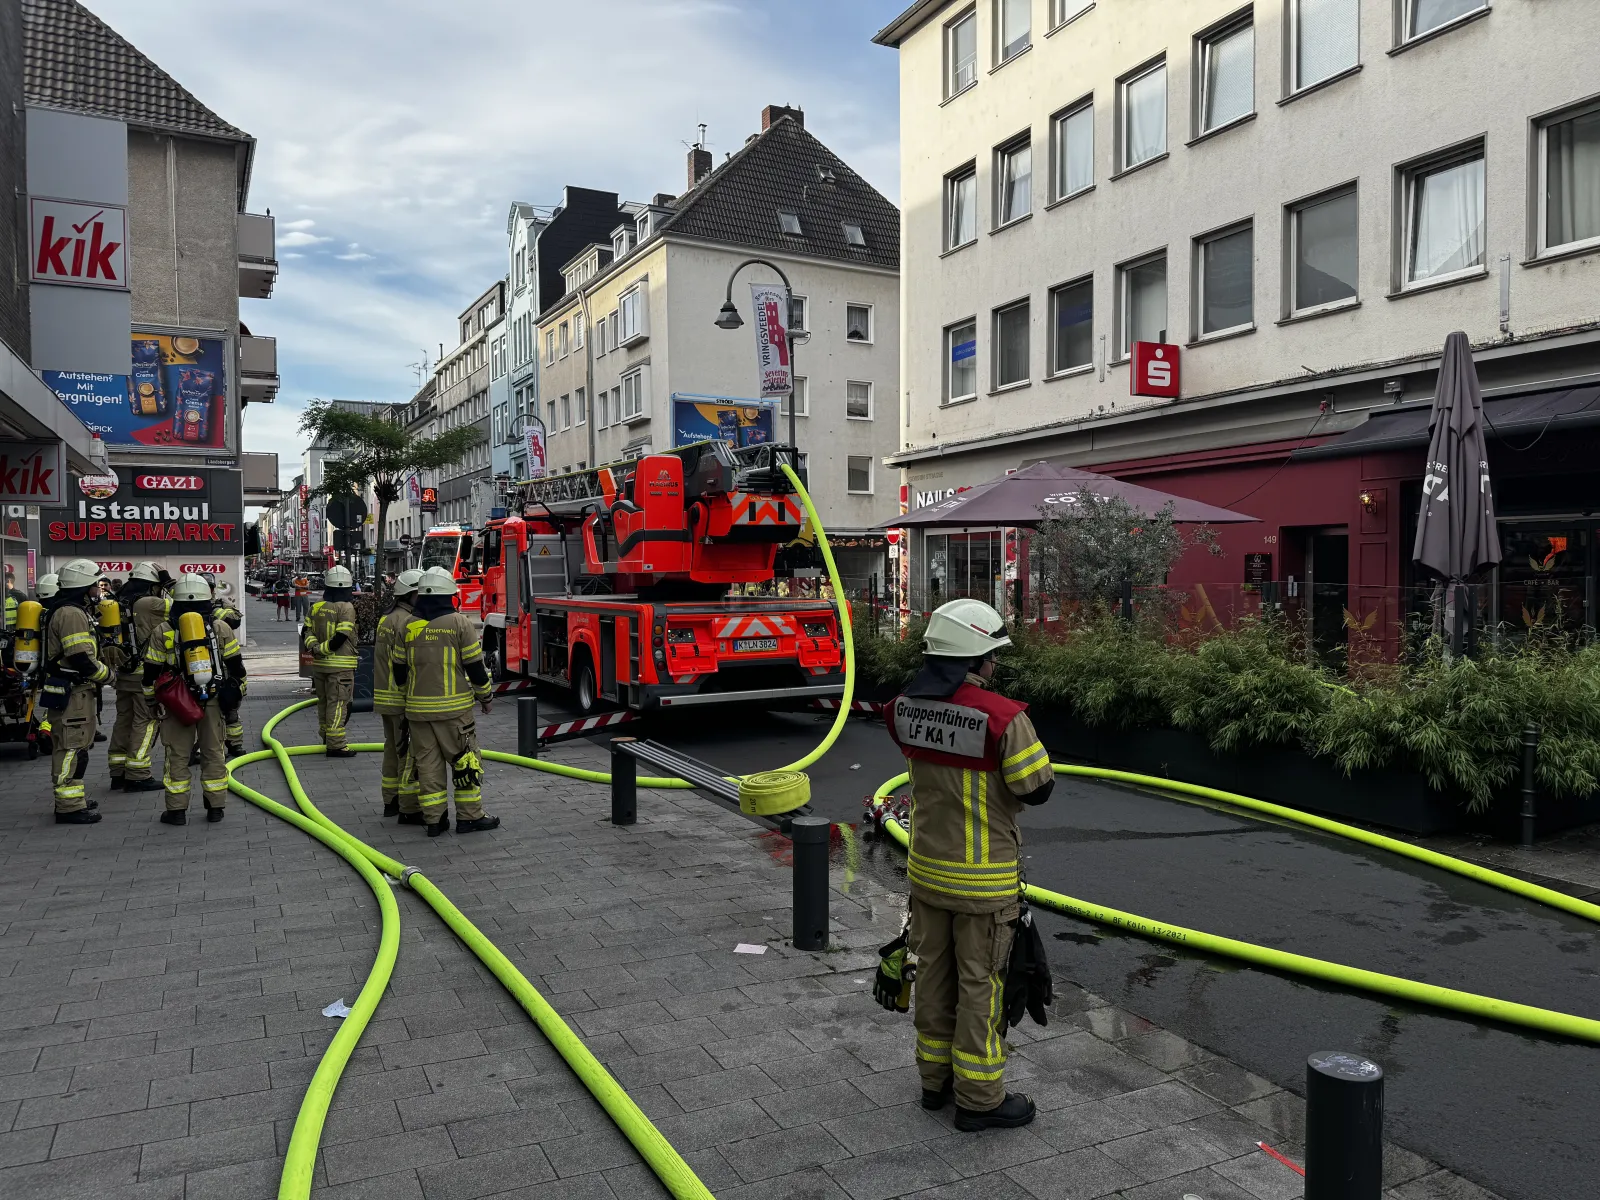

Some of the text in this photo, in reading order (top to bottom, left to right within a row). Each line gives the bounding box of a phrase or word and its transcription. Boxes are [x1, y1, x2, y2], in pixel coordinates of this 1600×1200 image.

[757, 302, 771, 367] VRINGSVEEDEL
[76, 382, 94, 391] Mit
[78, 501, 209, 520] Istanbul
[48, 521, 235, 541] SUPERMARKT
[1263, 535, 1277, 544] 149
[896, 701, 984, 731] Gruppenführer
[908, 722, 956, 747] LF KA 1
[1126, 919, 1147, 931] Köln
[1152, 926, 1187, 941] 13/2021
